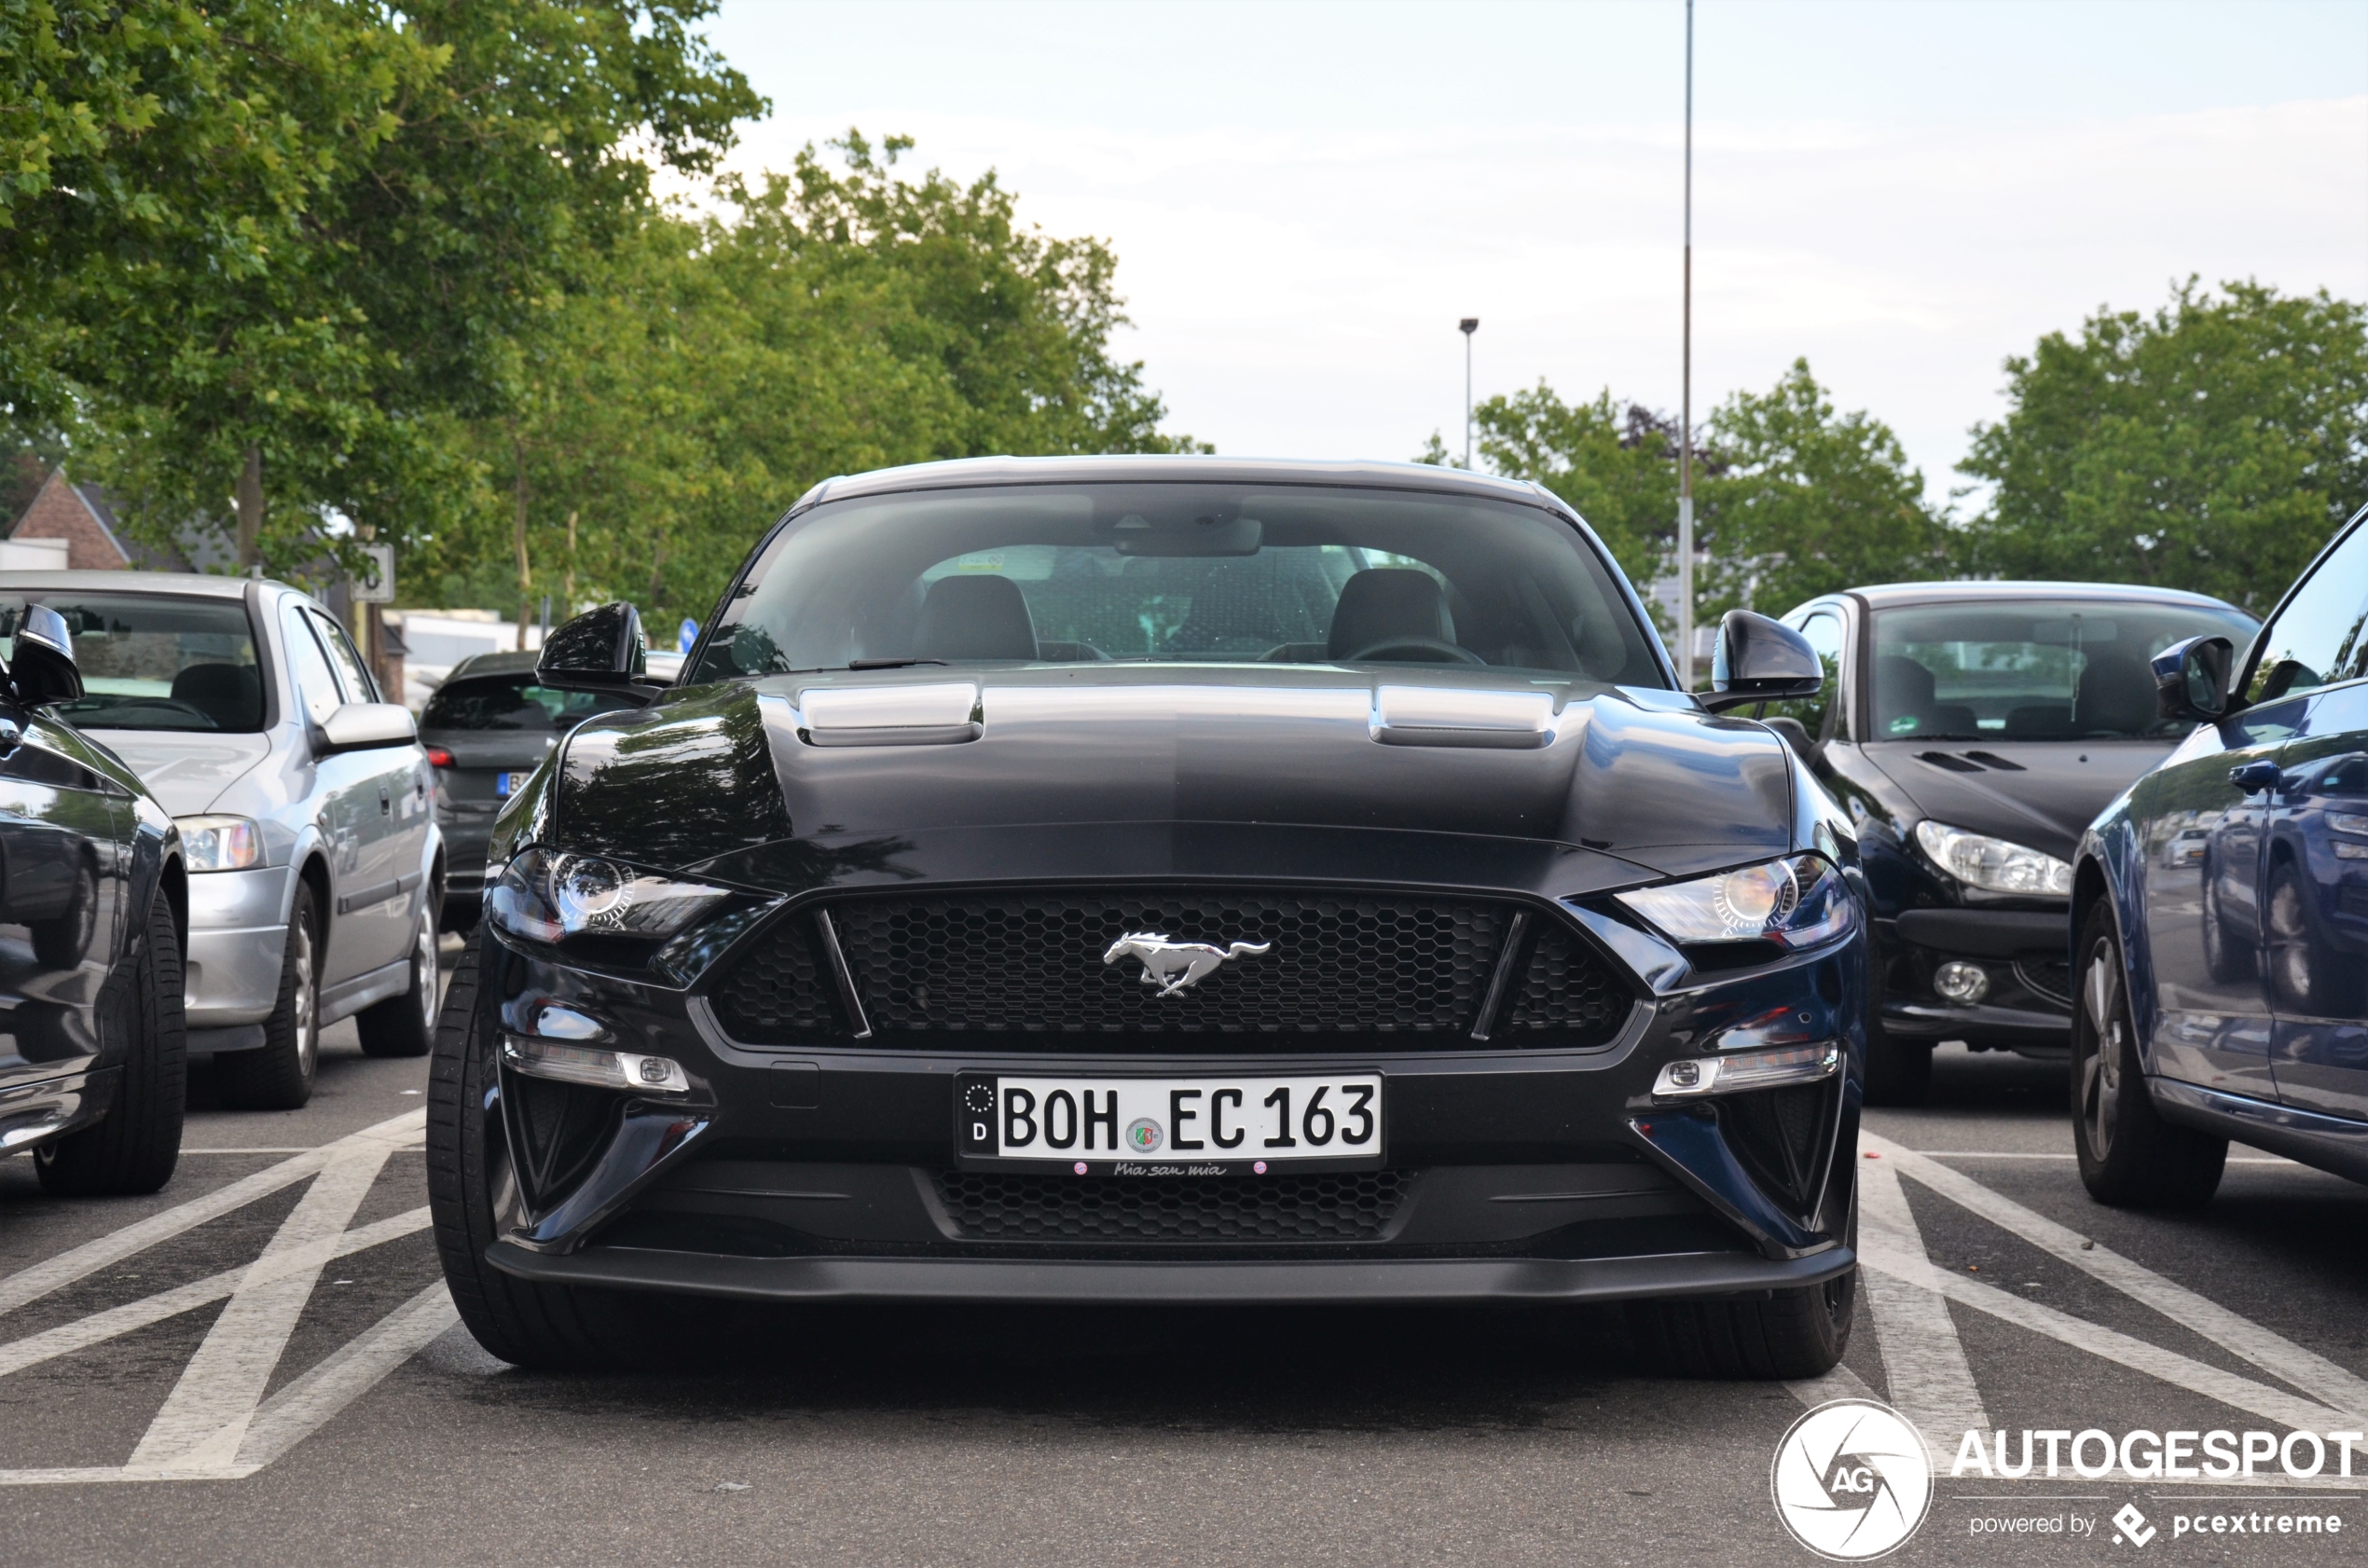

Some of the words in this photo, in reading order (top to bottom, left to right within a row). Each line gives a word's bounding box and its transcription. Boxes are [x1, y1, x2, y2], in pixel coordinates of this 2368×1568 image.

[1003, 1088, 1119, 1149] BOH
[1170, 1088, 1245, 1149] EC
[1263, 1084, 1374, 1148] 163
[972, 1122, 987, 1140] D
[1114, 1162, 1147, 1176] Mia
[1148, 1165, 1185, 1176] san
[1188, 1162, 1227, 1176] mia
